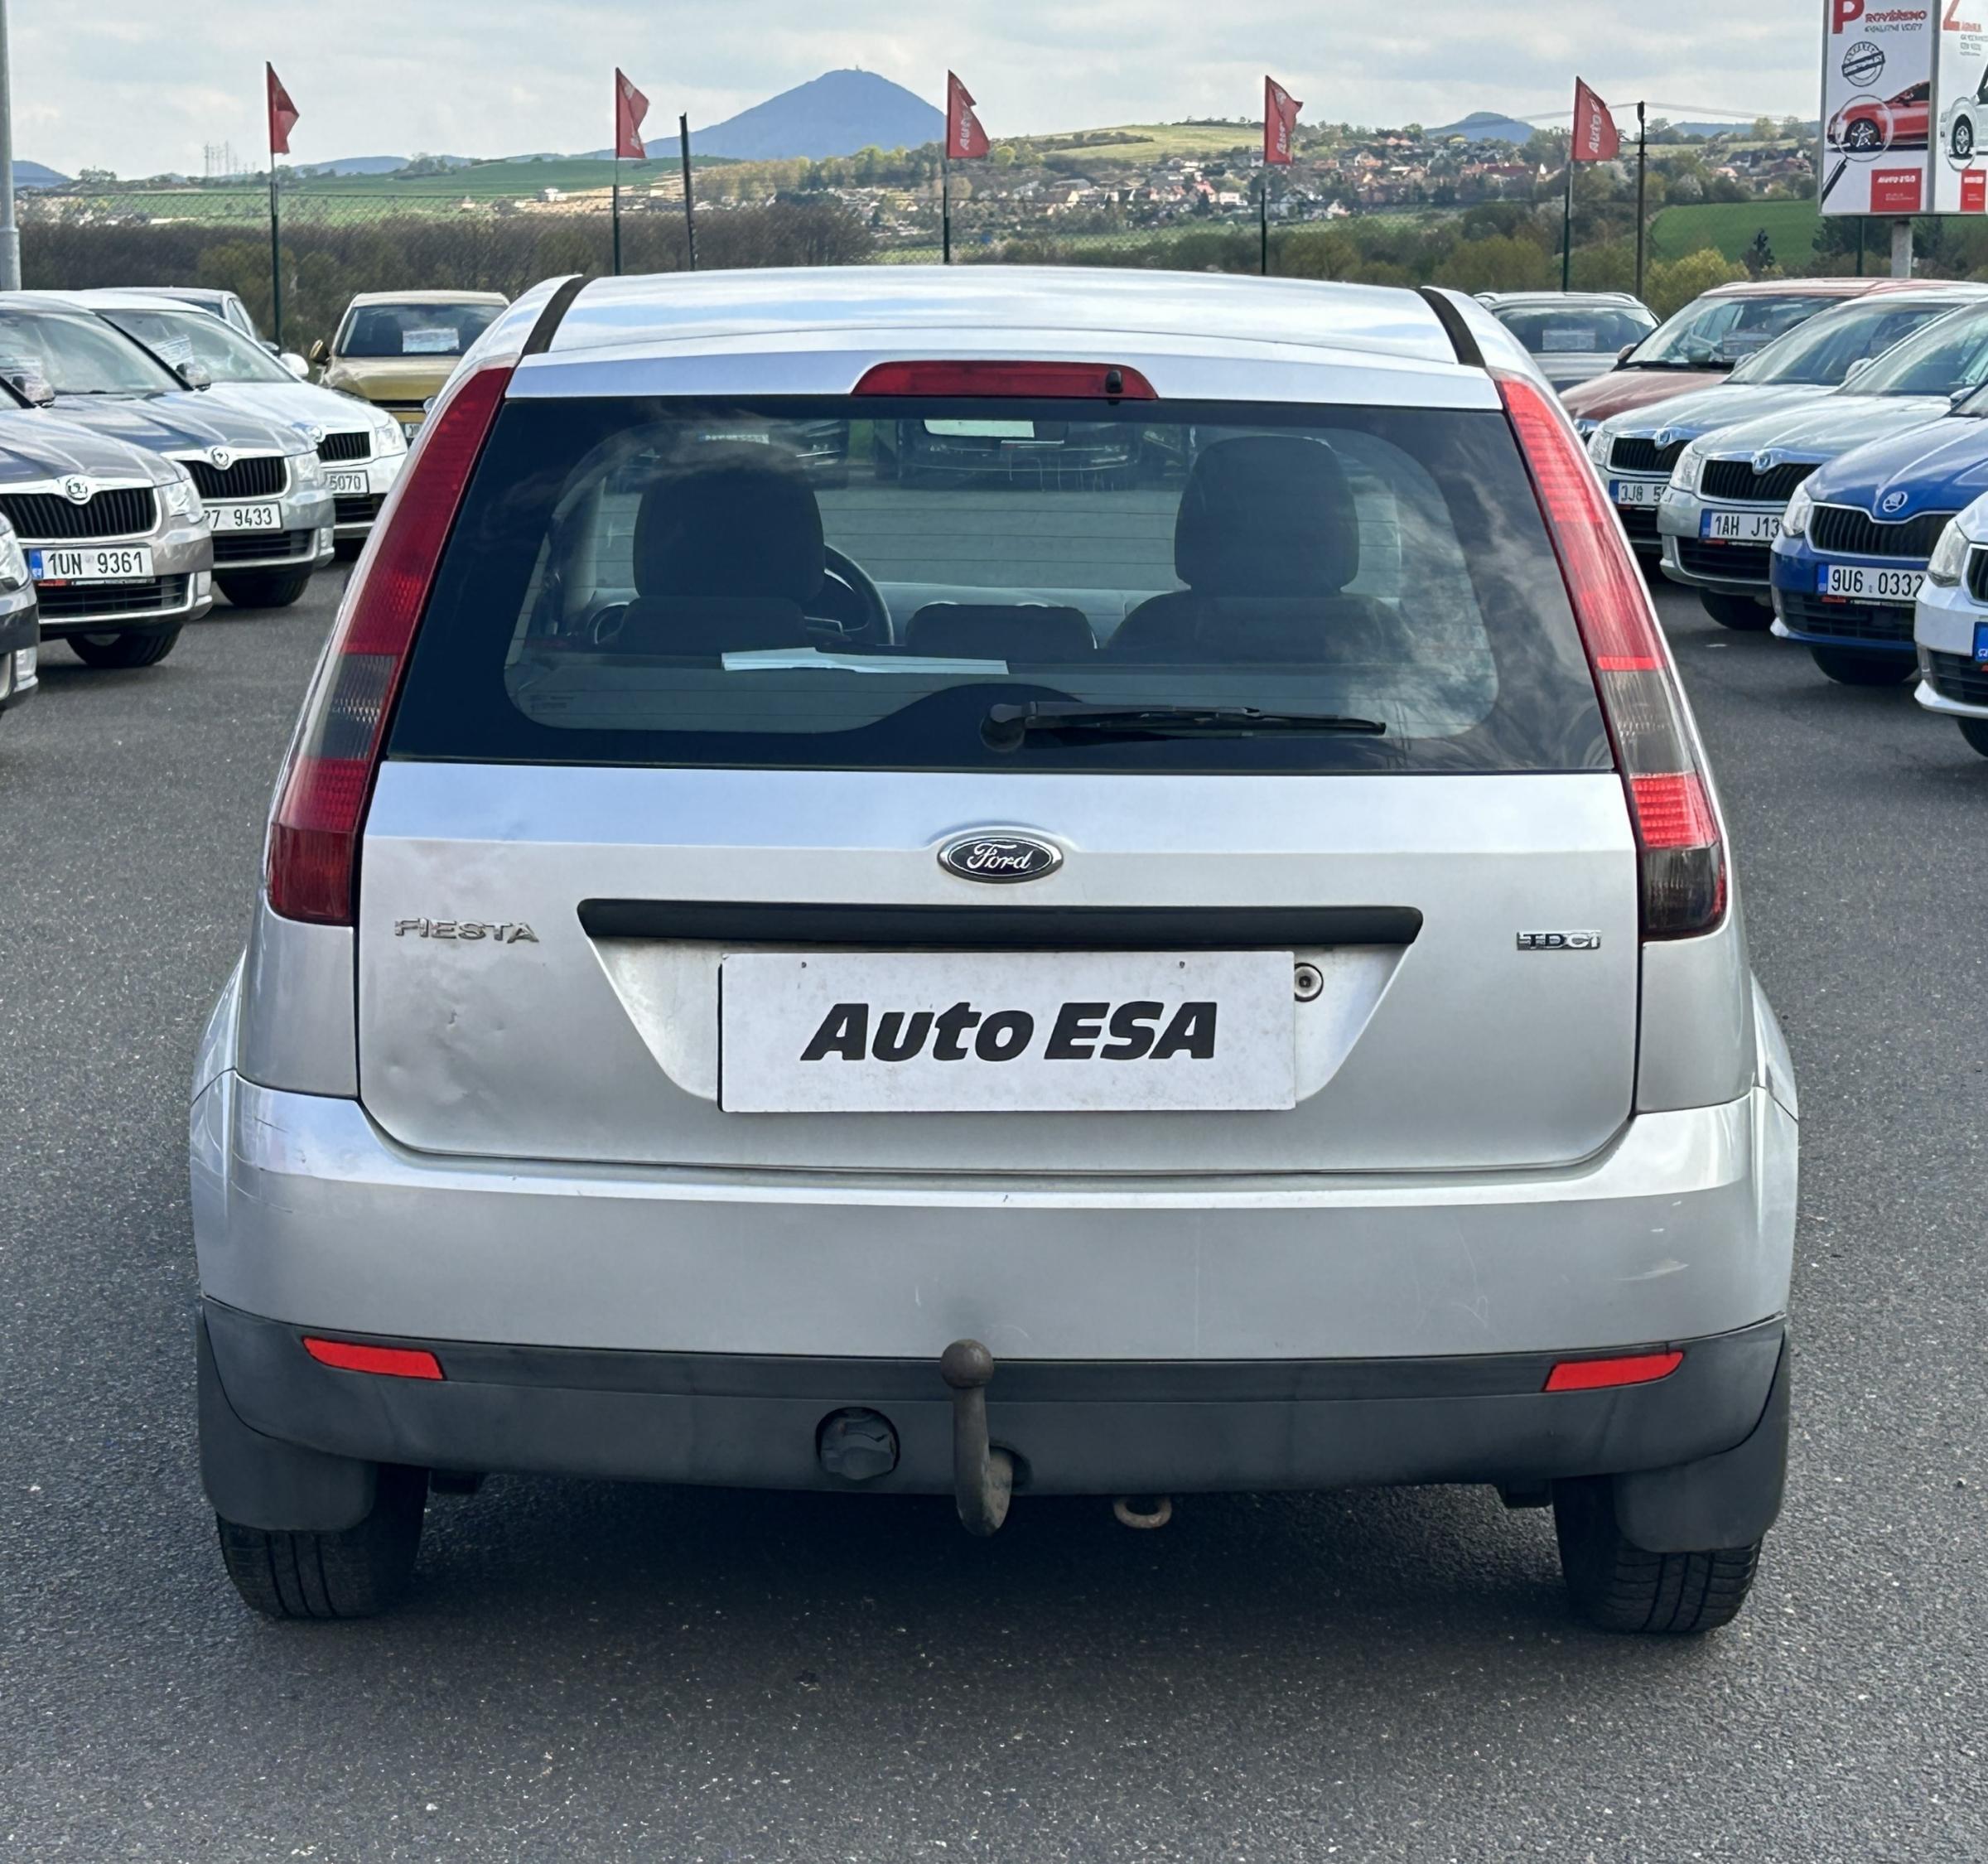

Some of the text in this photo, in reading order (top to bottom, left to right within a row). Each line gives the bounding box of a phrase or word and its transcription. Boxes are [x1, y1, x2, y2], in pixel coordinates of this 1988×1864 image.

[234, 507, 272, 527] 9433
[1715, 515, 1740, 536] 1AH
[48, 553, 82, 575] 1UN
[97, 551, 142, 573] 9361
[1831, 569, 1863, 592] 9U6
[967, 843, 1037, 869] Ford
[394, 918, 540, 944] FIESTA
[799, 1001, 1218, 1061] Auto ESA
